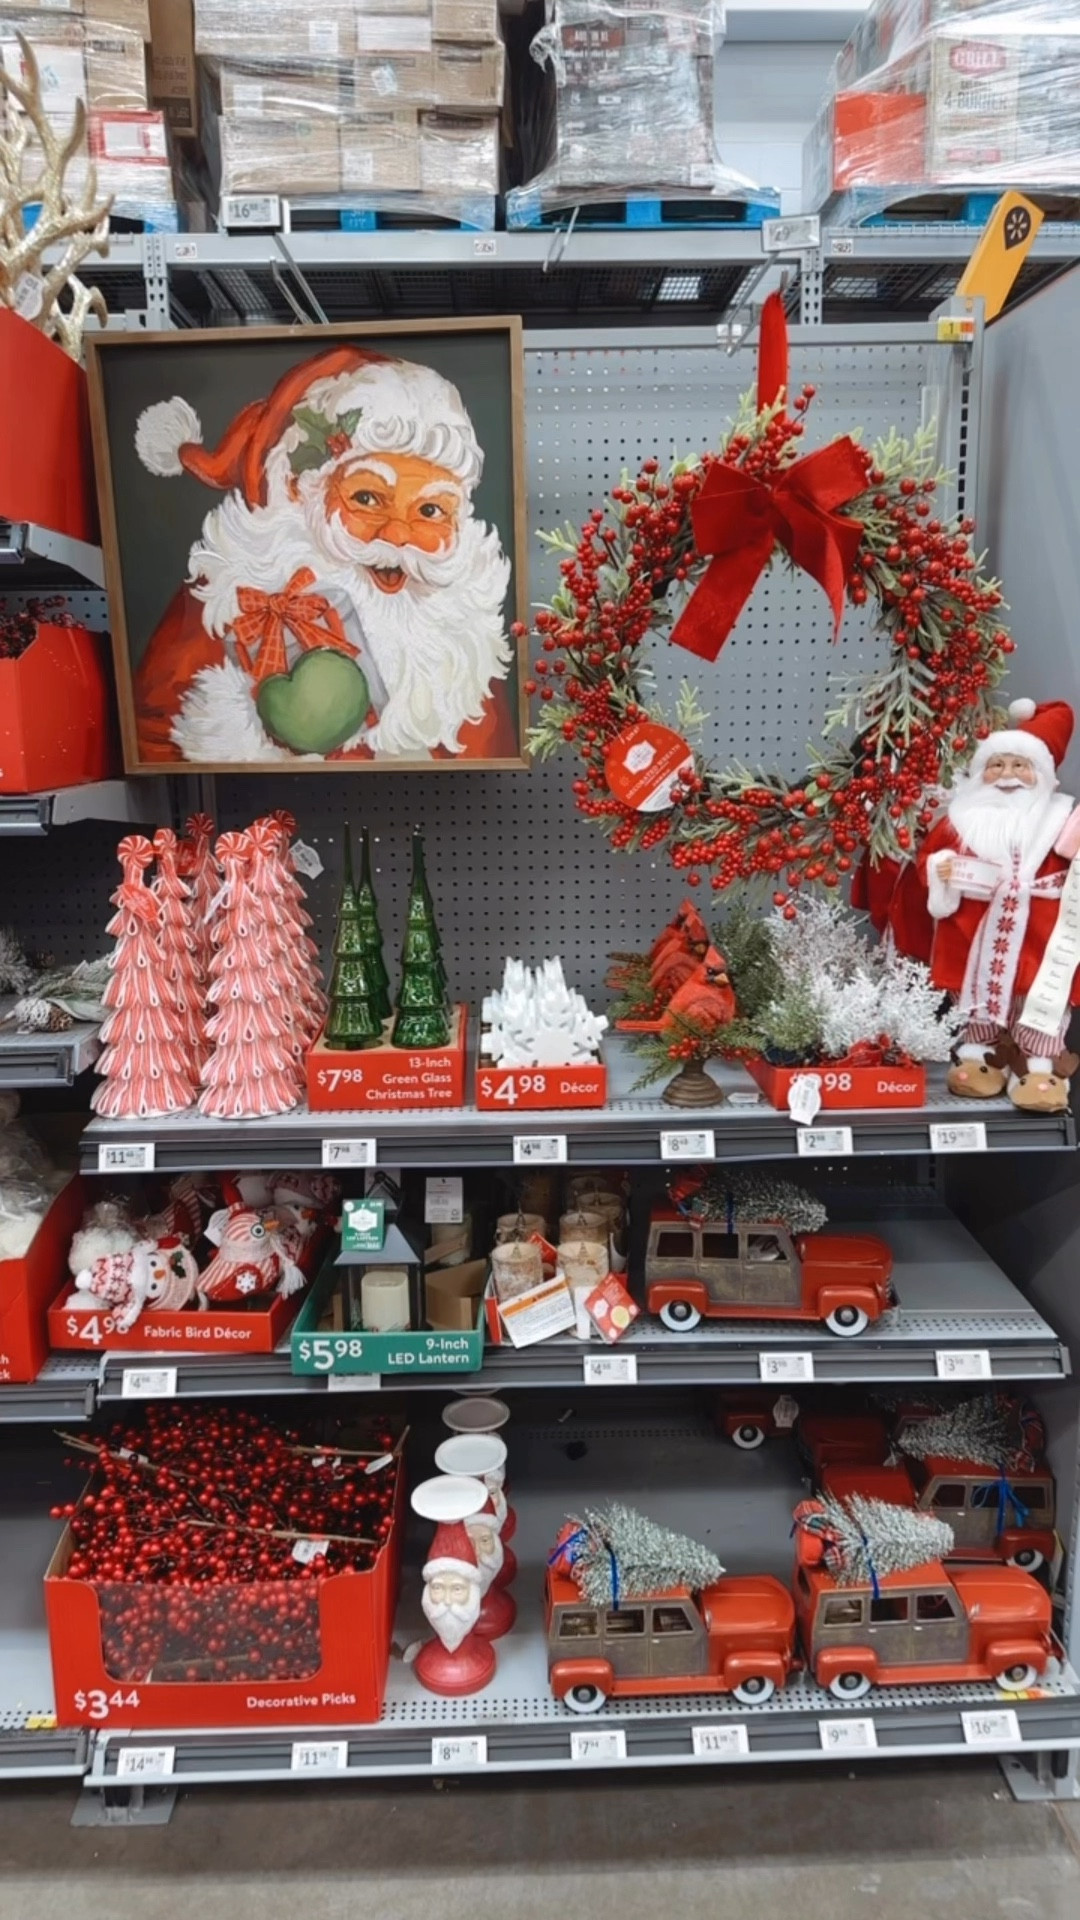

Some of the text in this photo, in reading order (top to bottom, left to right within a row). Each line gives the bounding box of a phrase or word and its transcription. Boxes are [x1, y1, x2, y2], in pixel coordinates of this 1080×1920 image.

[409, 1056, 452, 1068] 13-Inch
[382, 1073, 418, 1084] Green
[421, 1072, 452, 1084] Glass
[560, 1081, 599, 1094] Décor
[877, 1080, 917, 1093] Décor
[366, 1087, 452, 1100] Christmas Tree
[144, 1326, 182, 1338] Fabric
[185, 1326, 211, 1338] Bird
[214, 1326, 252, 1339] Décor
[426, 1338, 469, 1350] 9-Inch
[388, 1353, 415, 1365] LED
[419, 1352, 470, 1364] Lantern
[246, 1694, 319, 1708] Decorative
[322, 1693, 356, 1706] Picks
